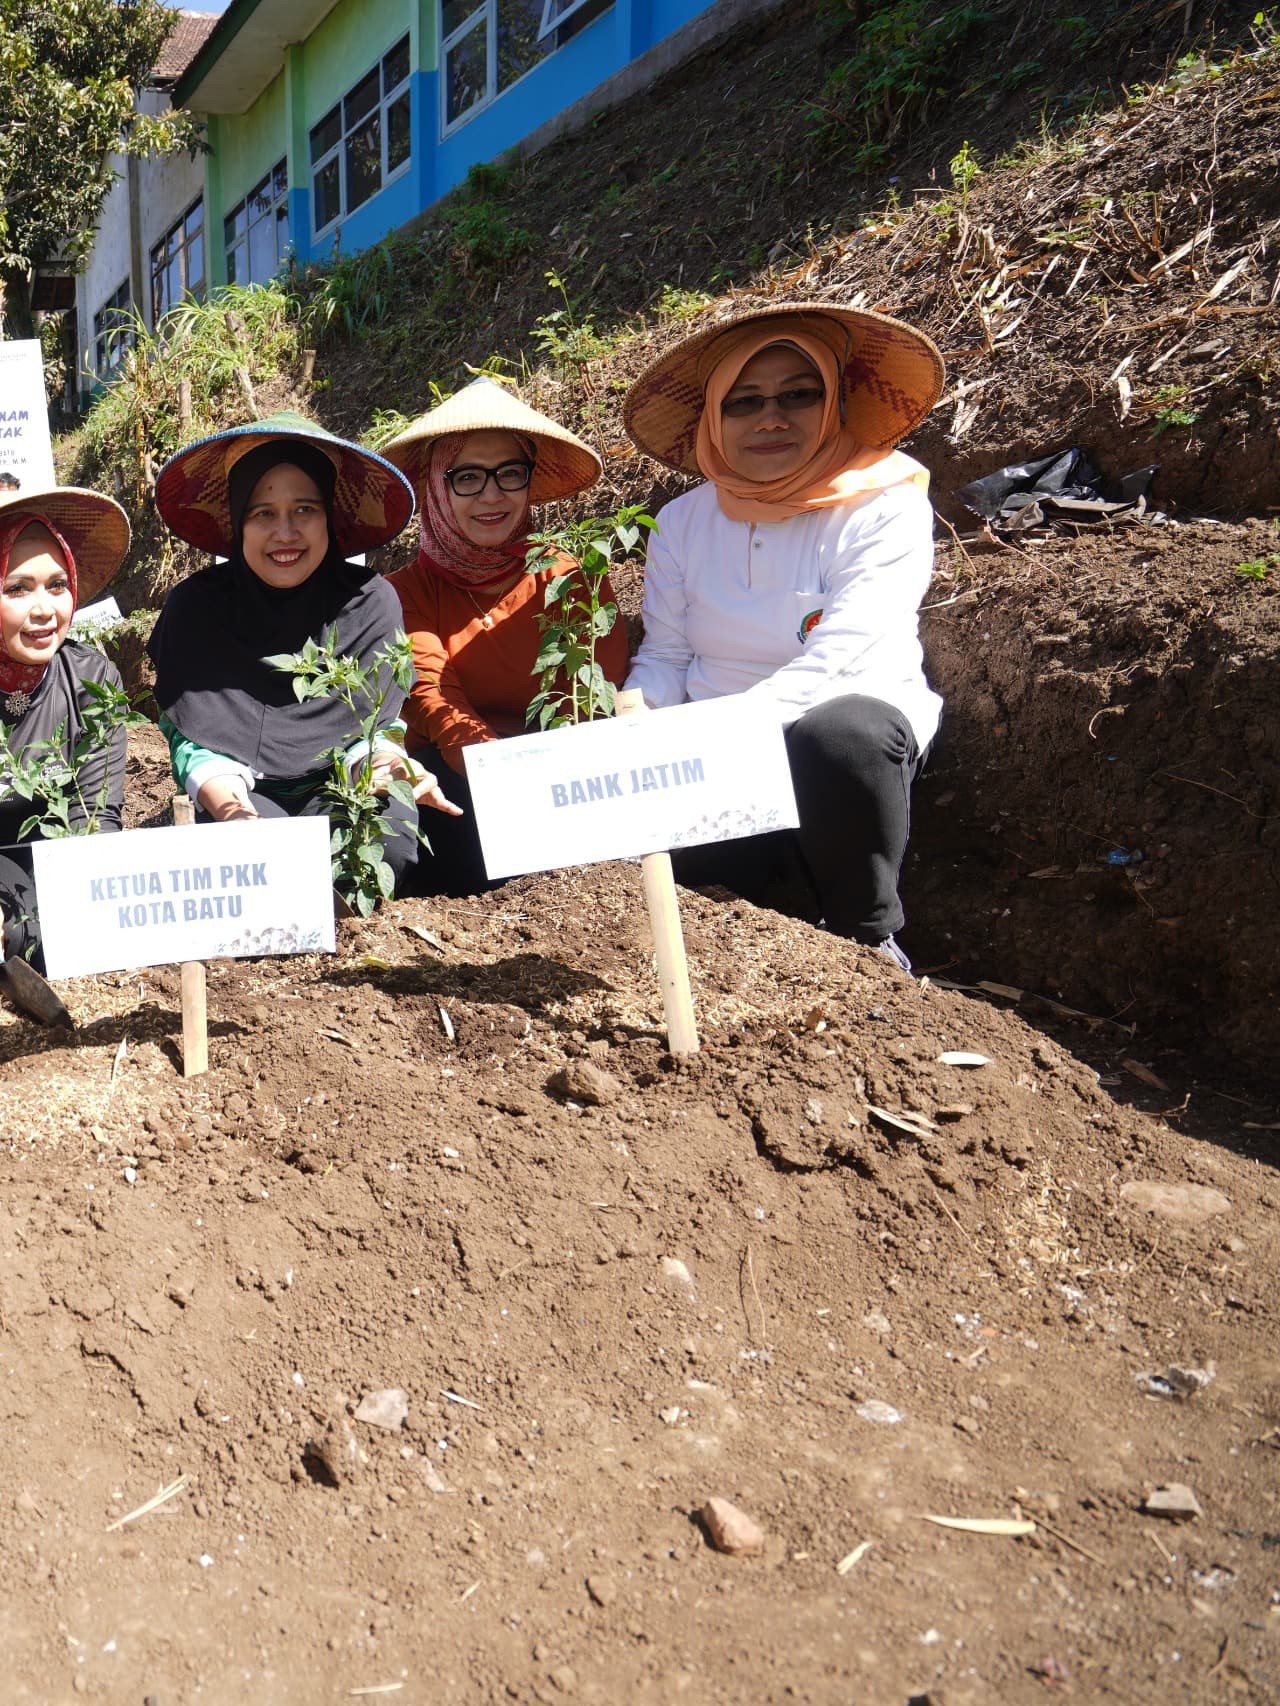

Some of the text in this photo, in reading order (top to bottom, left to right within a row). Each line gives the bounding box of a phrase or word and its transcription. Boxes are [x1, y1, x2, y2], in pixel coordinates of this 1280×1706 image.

[550, 758, 705, 808] BANK JATIM
[90, 862, 268, 901] KETUA TIM PKK
[118, 894, 243, 928] KOTA BATU
